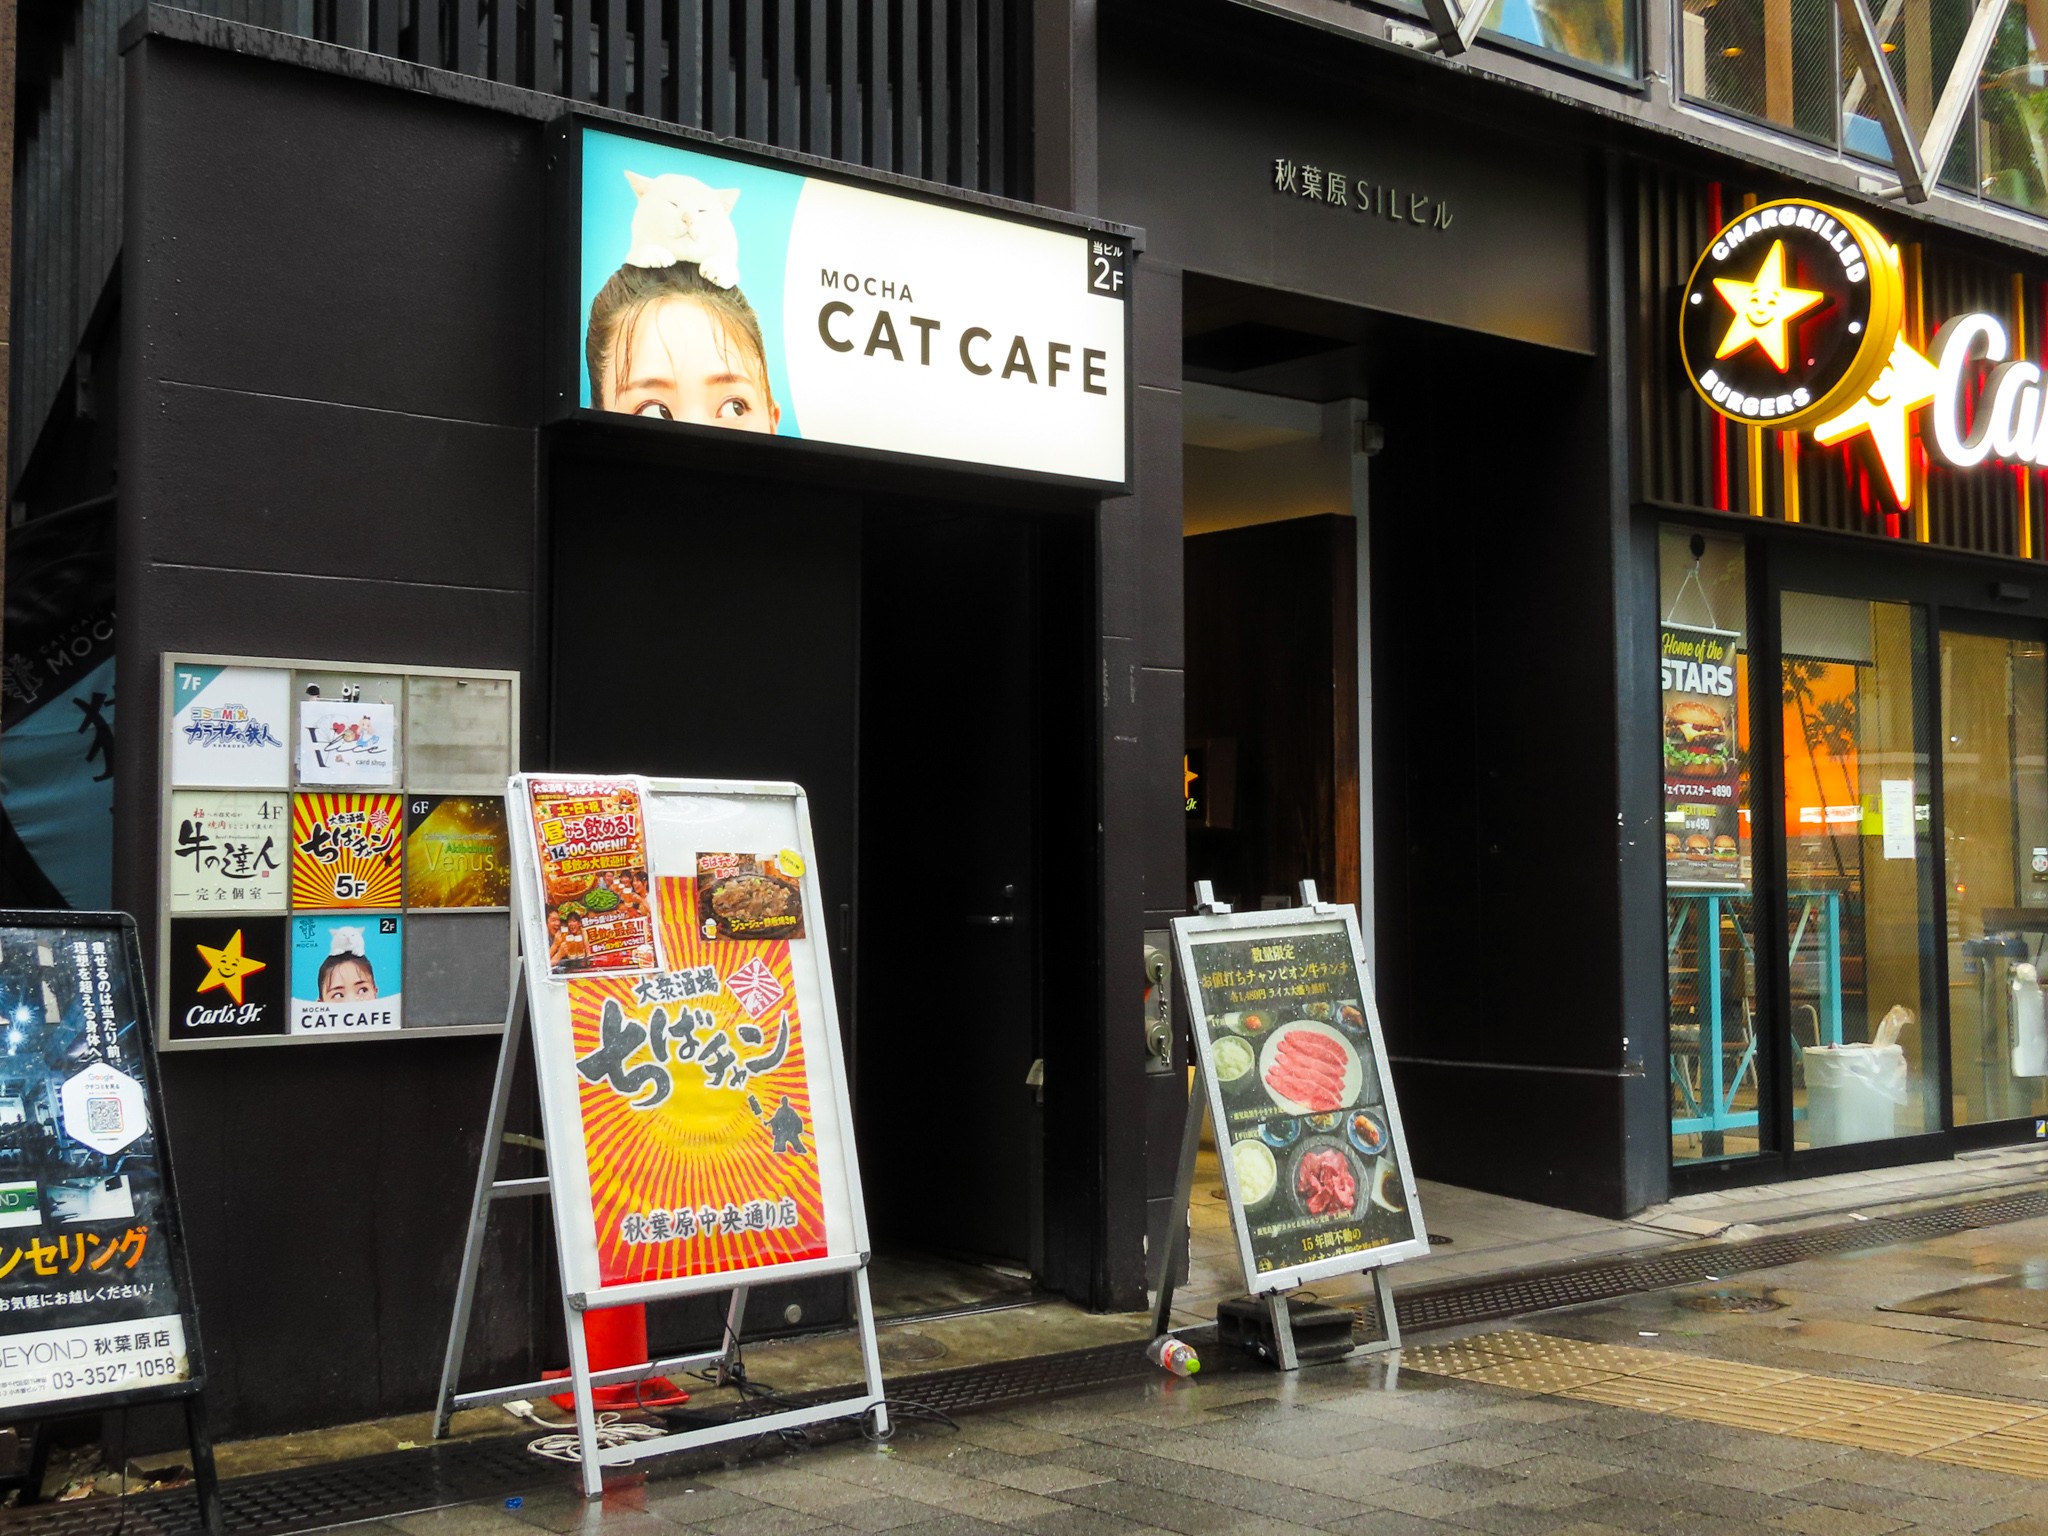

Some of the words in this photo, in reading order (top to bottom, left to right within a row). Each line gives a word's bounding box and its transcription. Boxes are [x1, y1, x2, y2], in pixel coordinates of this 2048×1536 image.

[1093, 241, 1123, 257] 当ビル
[1711, 206, 1866, 283] CHARGRILLED
[820, 268, 913, 303] MOCHA
[1093, 257, 1123, 291] 2F
[817, 300, 941, 366] CAT
[958, 326, 1107, 396] CAFE
[1699, 369, 1811, 417] BURGERS
[46, 611, 117, 676] MOC
[1662, 633, 1694, 656] Home
[1695, 639, 1706, 664] of
[1707, 640, 1723, 660] the
[179, 673, 201, 691] 7F
[1662, 658, 1733, 697] STARS
[184, 720, 282, 747] カラオケの鉄人
[355, 758, 370, 766] card
[371, 759, 386, 768] shop
[1664, 784, 1711, 797] ェイマススター
[1712, 785, 1732, 798] ¥890
[258, 800, 283, 820] 4F
[412, 801, 429, 814] 6F
[175, 820, 281, 879] 牛の達人
[300, 823, 394, 863] ちばチャン
[425, 842, 494, 872] Venus
[196, 887, 262, 901] 完全個室
[336, 875, 365, 898] 5F
[382, 920, 395, 932] 2F
[635, 967, 719, 1004] 大衆酒場
[186, 1004, 236, 1027] Carl's
[237, 1003, 261, 1025] Jr.
[301, 1014, 338, 1029] CAT
[343, 1011, 391, 1027] CAFE
[577, 1000, 789, 1109] ちばチャン
[88, 1073, 114, 1081] Google
[624, 1199, 797, 1243] 秋葉原中央通り店
[94, 1330, 171, 1356] 秋葉原店
[53, 1357, 176, 1390] 03-3527-1058
